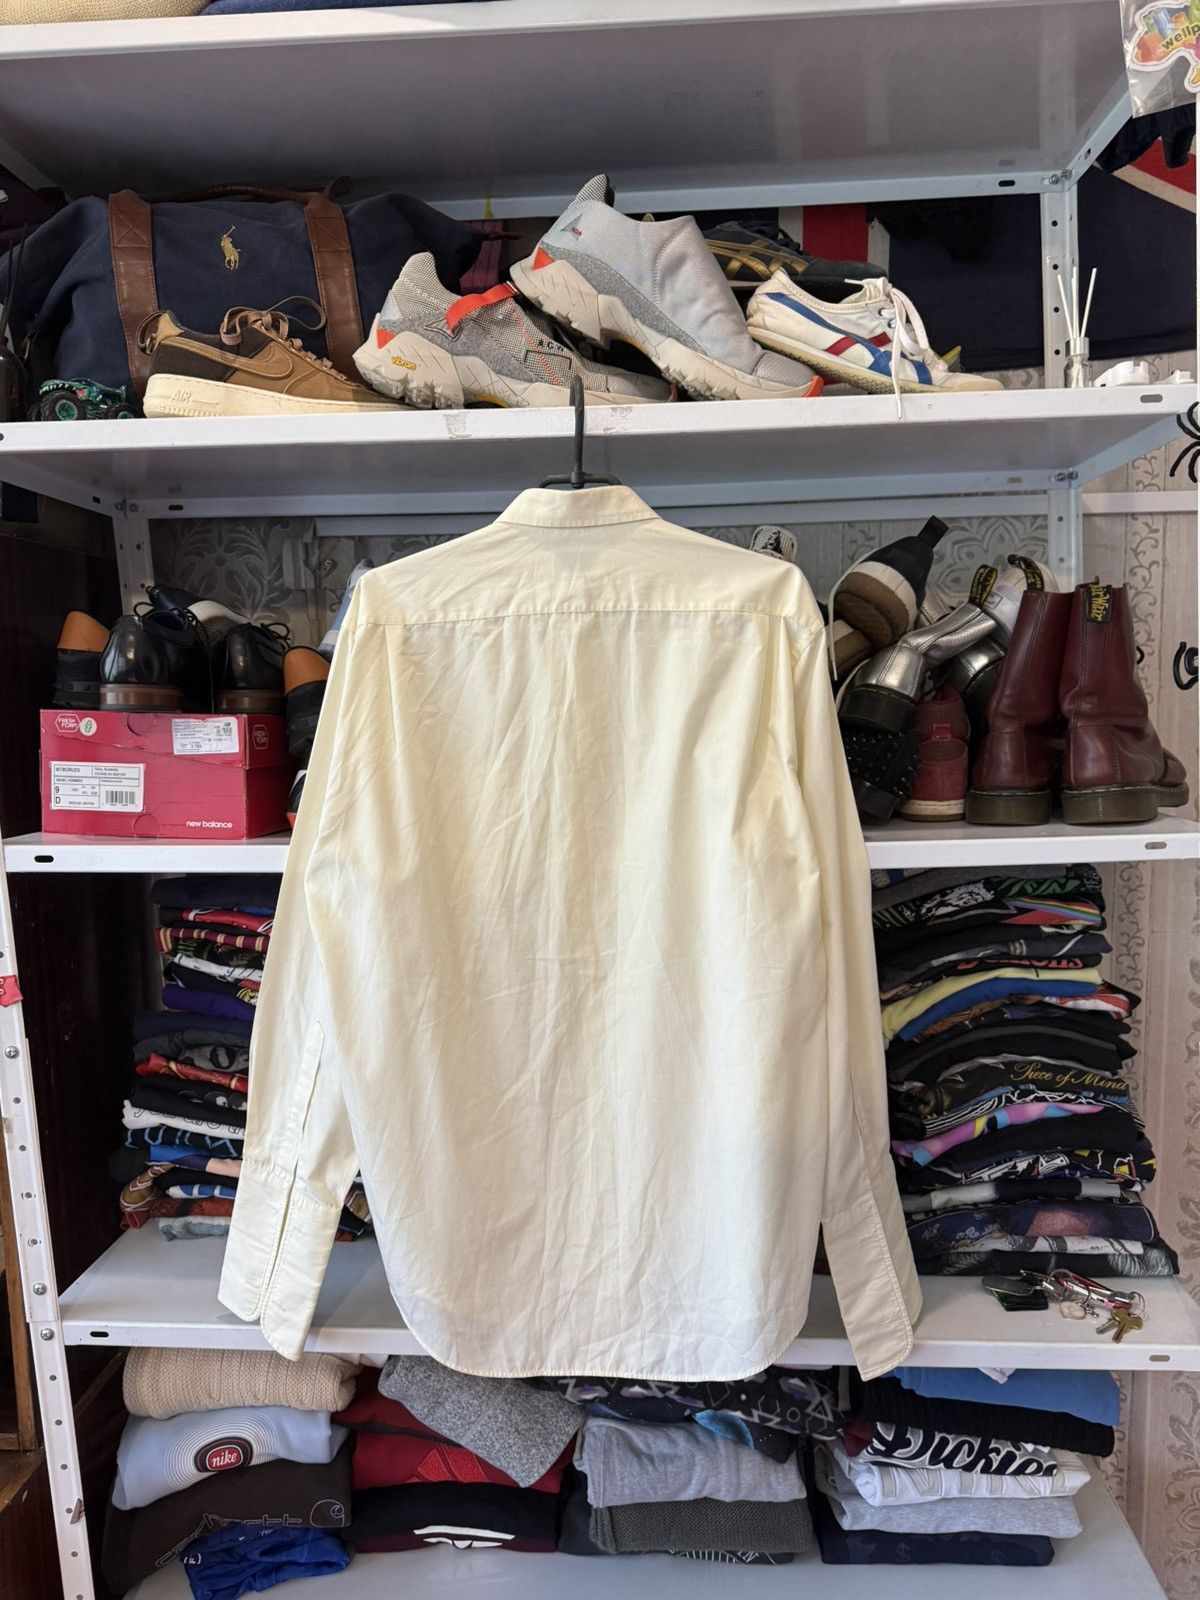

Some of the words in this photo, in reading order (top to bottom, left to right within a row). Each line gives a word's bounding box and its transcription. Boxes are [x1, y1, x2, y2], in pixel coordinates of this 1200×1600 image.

[55, 796, 61, 804] D
[202, 820, 233, 829] balance
[1011, 1061, 1053, 1081] Piece
[1055, 1068, 1079, 1088] of
[211, 1450, 238, 1468] nike
